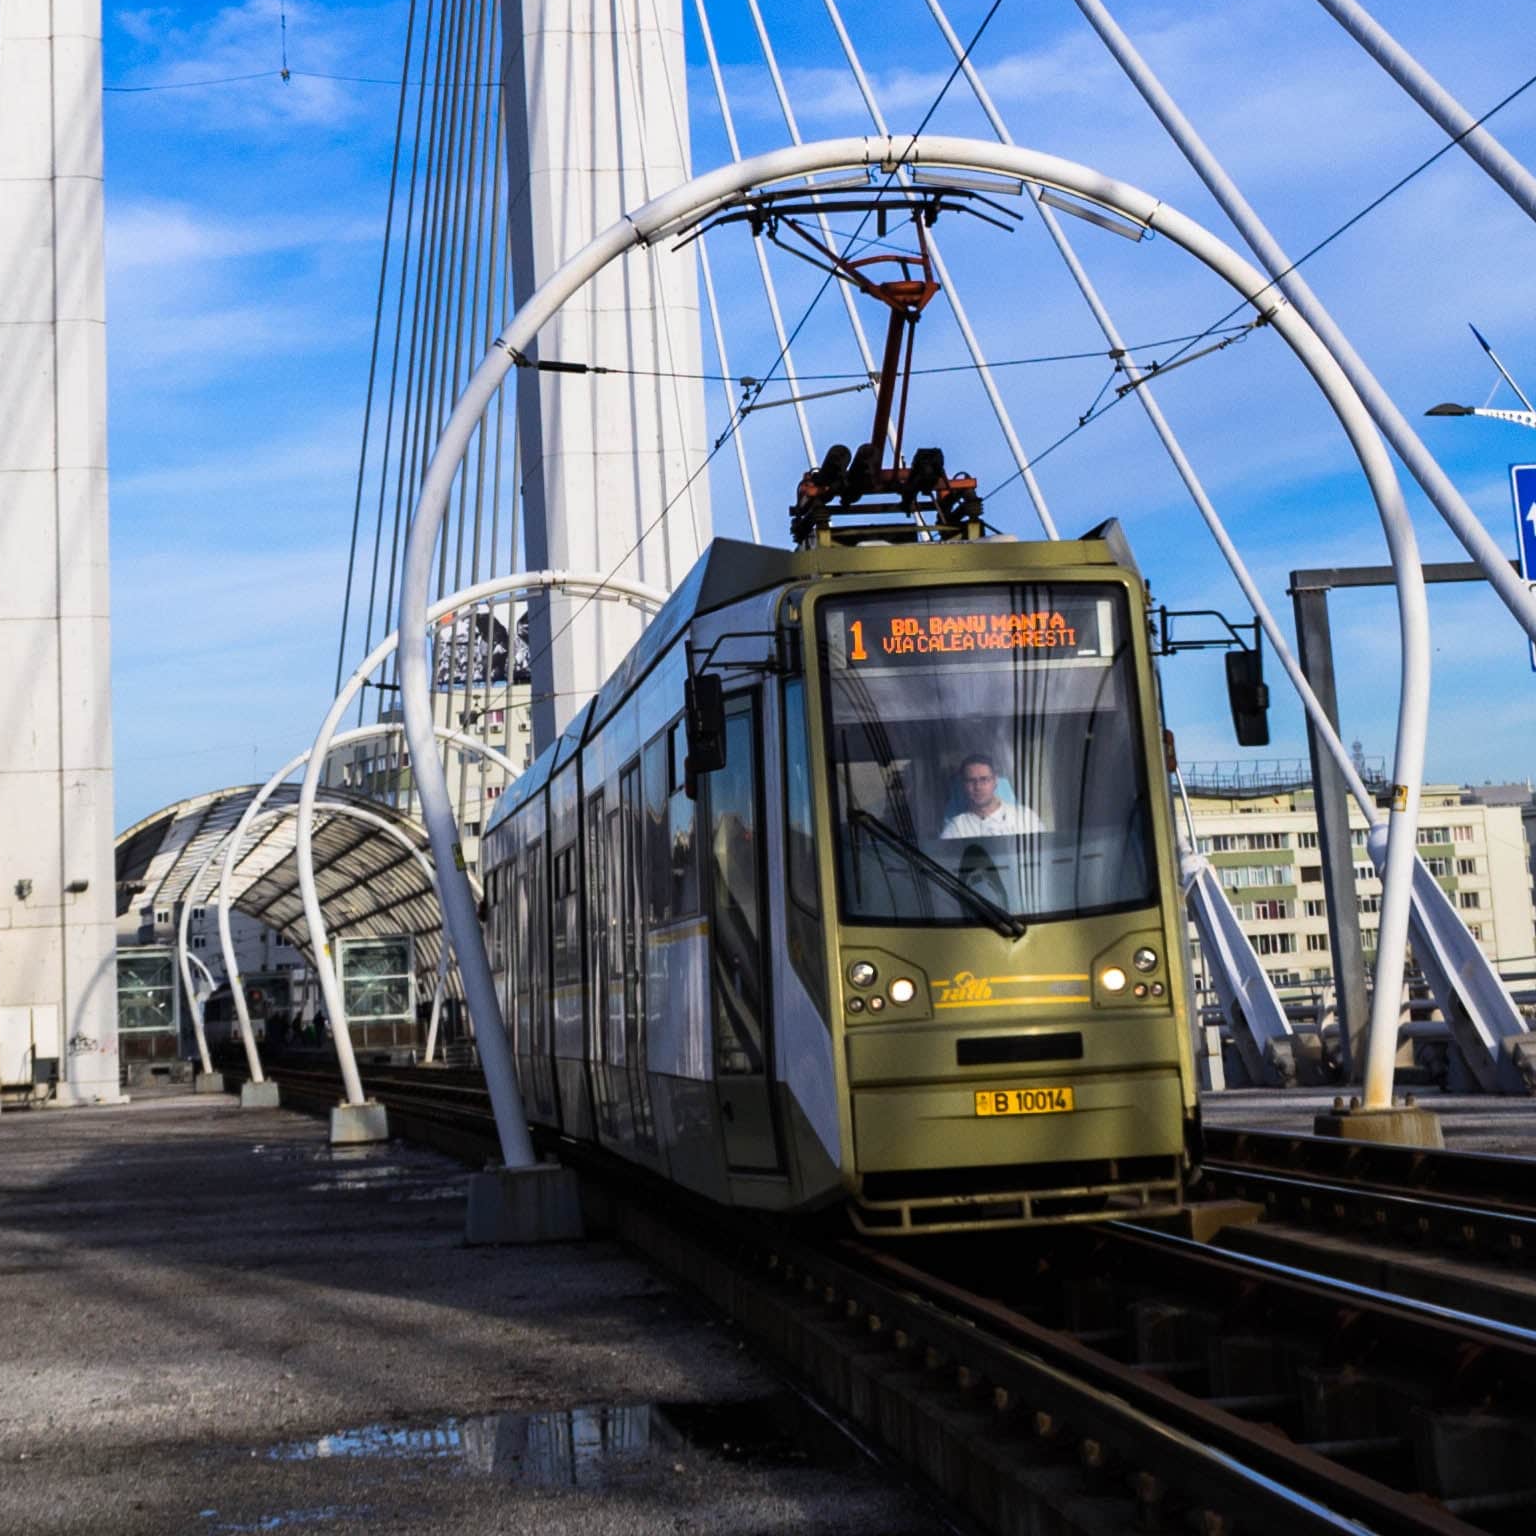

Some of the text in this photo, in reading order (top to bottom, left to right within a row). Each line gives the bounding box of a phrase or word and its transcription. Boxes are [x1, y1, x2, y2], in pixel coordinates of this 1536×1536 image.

[891, 612, 1066, 636] BD. BANU MANTA
[849, 620, 868, 660] 1
[883, 628, 1076, 654] VIA CALEA VACARESTI
[994, 1089, 1066, 1113] B 10014
